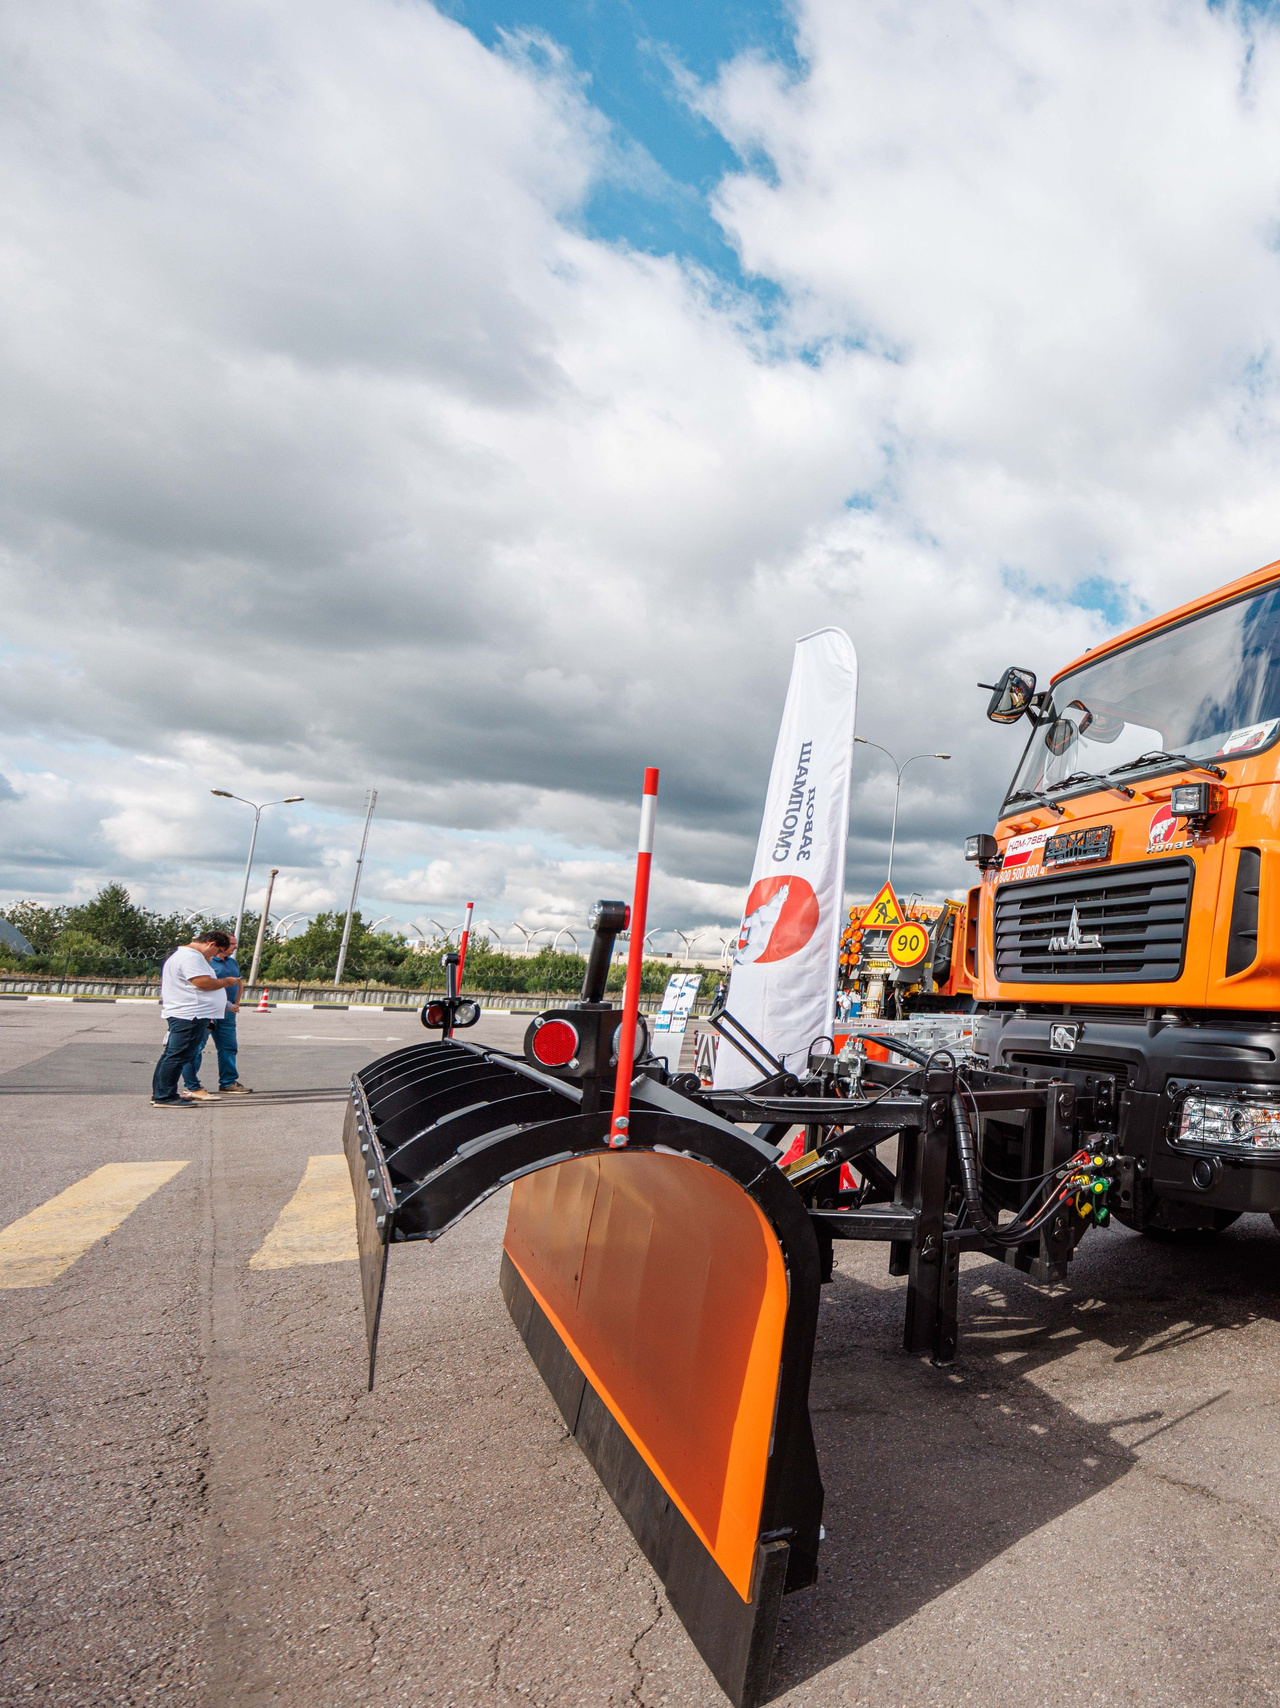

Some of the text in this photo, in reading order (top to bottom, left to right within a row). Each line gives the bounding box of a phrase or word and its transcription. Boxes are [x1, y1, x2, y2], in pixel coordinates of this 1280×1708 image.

[1008, 833, 1048, 852] КДМ-7881
[999, 869, 1012, 883] 800
[1011, 867, 1025, 880] 500
[1025, 864, 1039, 878] 800
[1040, 867, 1045, 876] 4
[897, 935, 920, 952] 90
